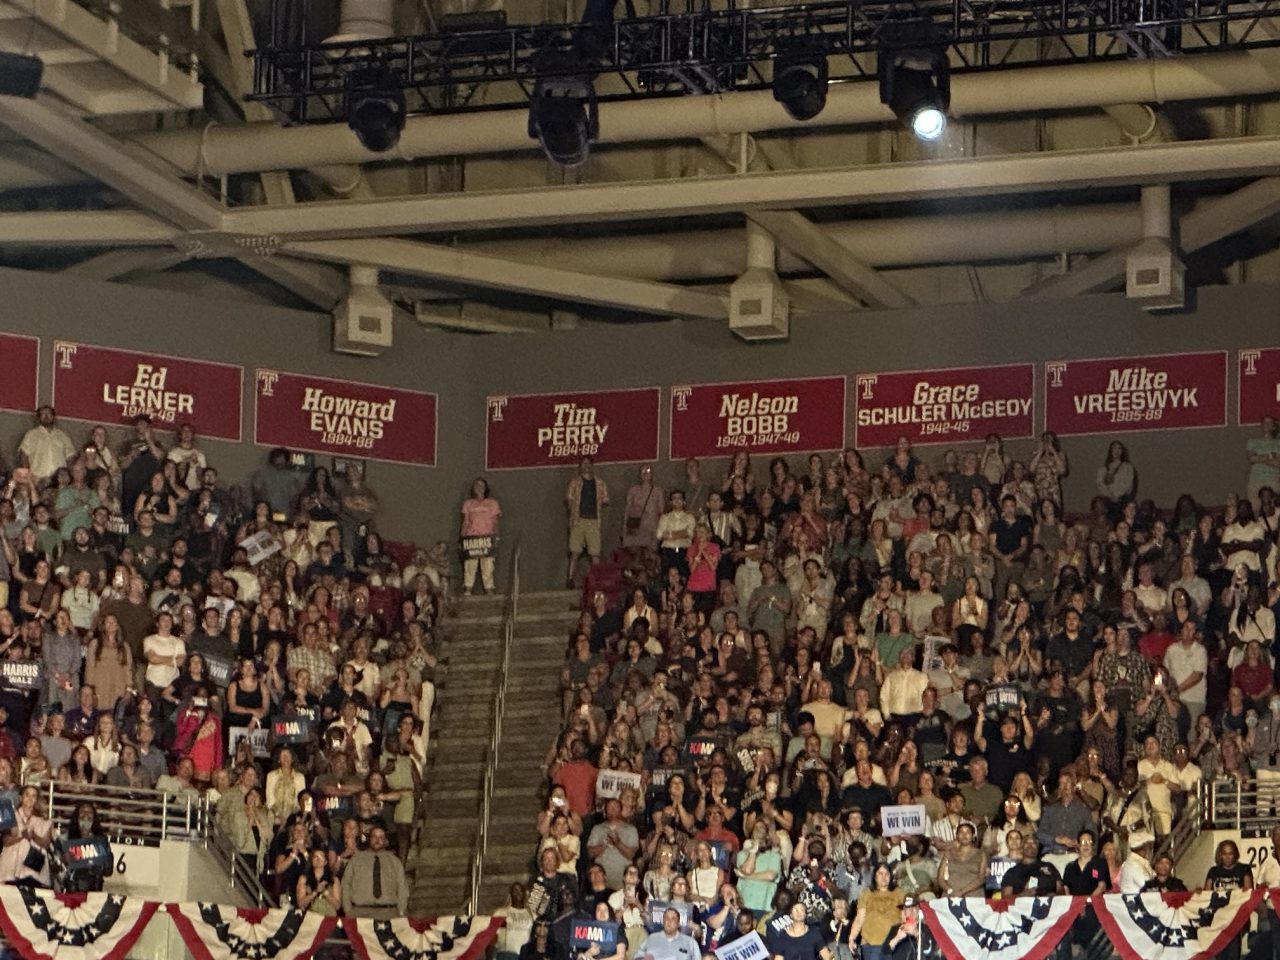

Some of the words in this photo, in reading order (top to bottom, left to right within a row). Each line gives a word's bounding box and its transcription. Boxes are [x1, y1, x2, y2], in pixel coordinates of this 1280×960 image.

[134, 364, 167, 390] Ed
[1107, 368, 1168, 393] Mike
[103, 383, 194, 414] LERNER
[302, 387, 396, 422] Howard
[719, 392, 799, 417] Nelson
[913, 382, 980, 406] Grace
[1073, 388, 1199, 414] VREESWYK
[554, 403, 597, 427] Tim
[858, 404, 946, 426] SCHULER
[951, 398, 1032, 420] McGEOY
[1110, 409, 1162, 423] 1985-89
[311, 412, 384, 440] EVANS
[538, 424, 609, 448] PERRY
[727, 415, 788, 436] BOBB
[920, 421, 970, 435] 1942-45
[751, 431, 800, 446] 1947-49
[3, 662, 39, 678] HARRIS
[887, 816, 900, 829] WE
[901, 815, 921, 828] WIN
[739, 943, 759, 960] WIN
